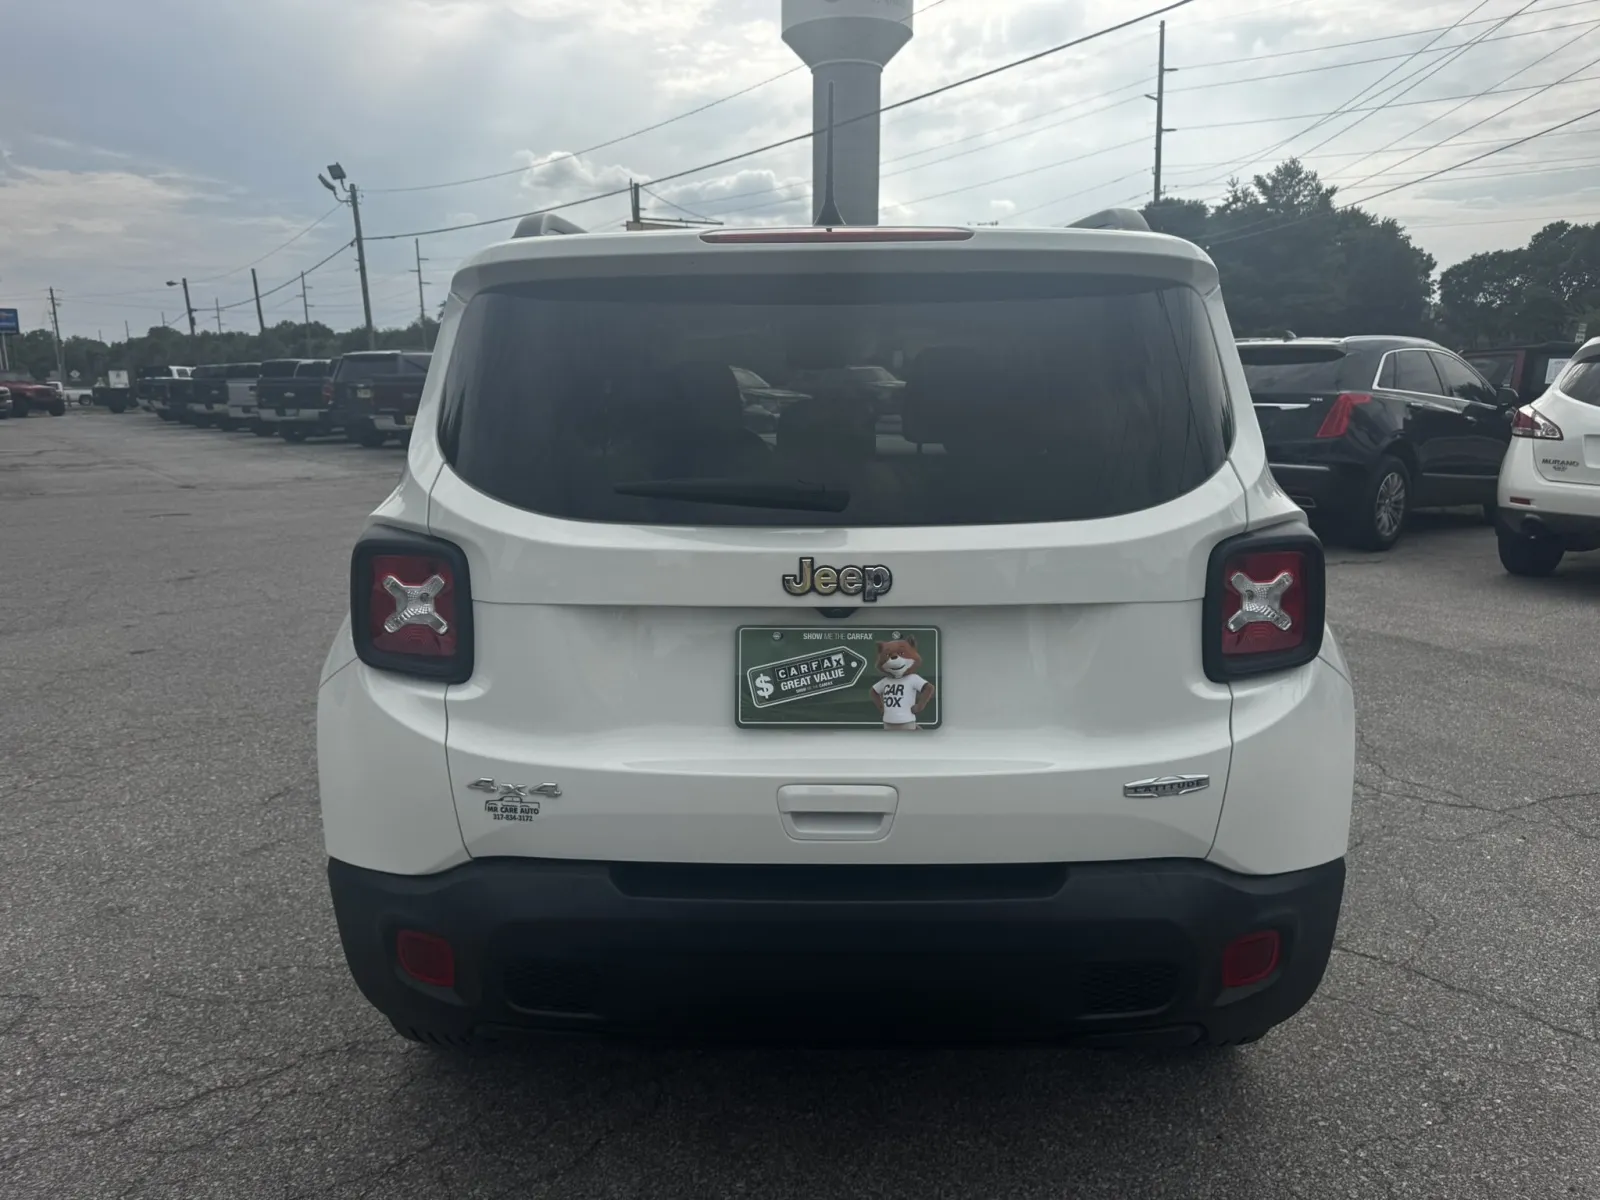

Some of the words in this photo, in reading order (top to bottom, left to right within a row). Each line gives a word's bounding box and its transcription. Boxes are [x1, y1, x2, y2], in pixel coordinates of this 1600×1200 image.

[1541, 458, 1580, 468] MURANO
[782, 556, 893, 602] Jeep
[802, 632, 823, 640] SHOW
[823, 632, 833, 640] ME
[846, 632, 873, 640] CARFAX
[777, 655, 844, 679] CARFAX
[755, 673, 774, 699] $
[780, 675, 812, 691] GREAT
[813, 668, 845, 683] VALUE
[884, 684, 905, 696] CAR
[500, 806, 519, 814] CARE
[520, 807, 540, 815] AUTO
